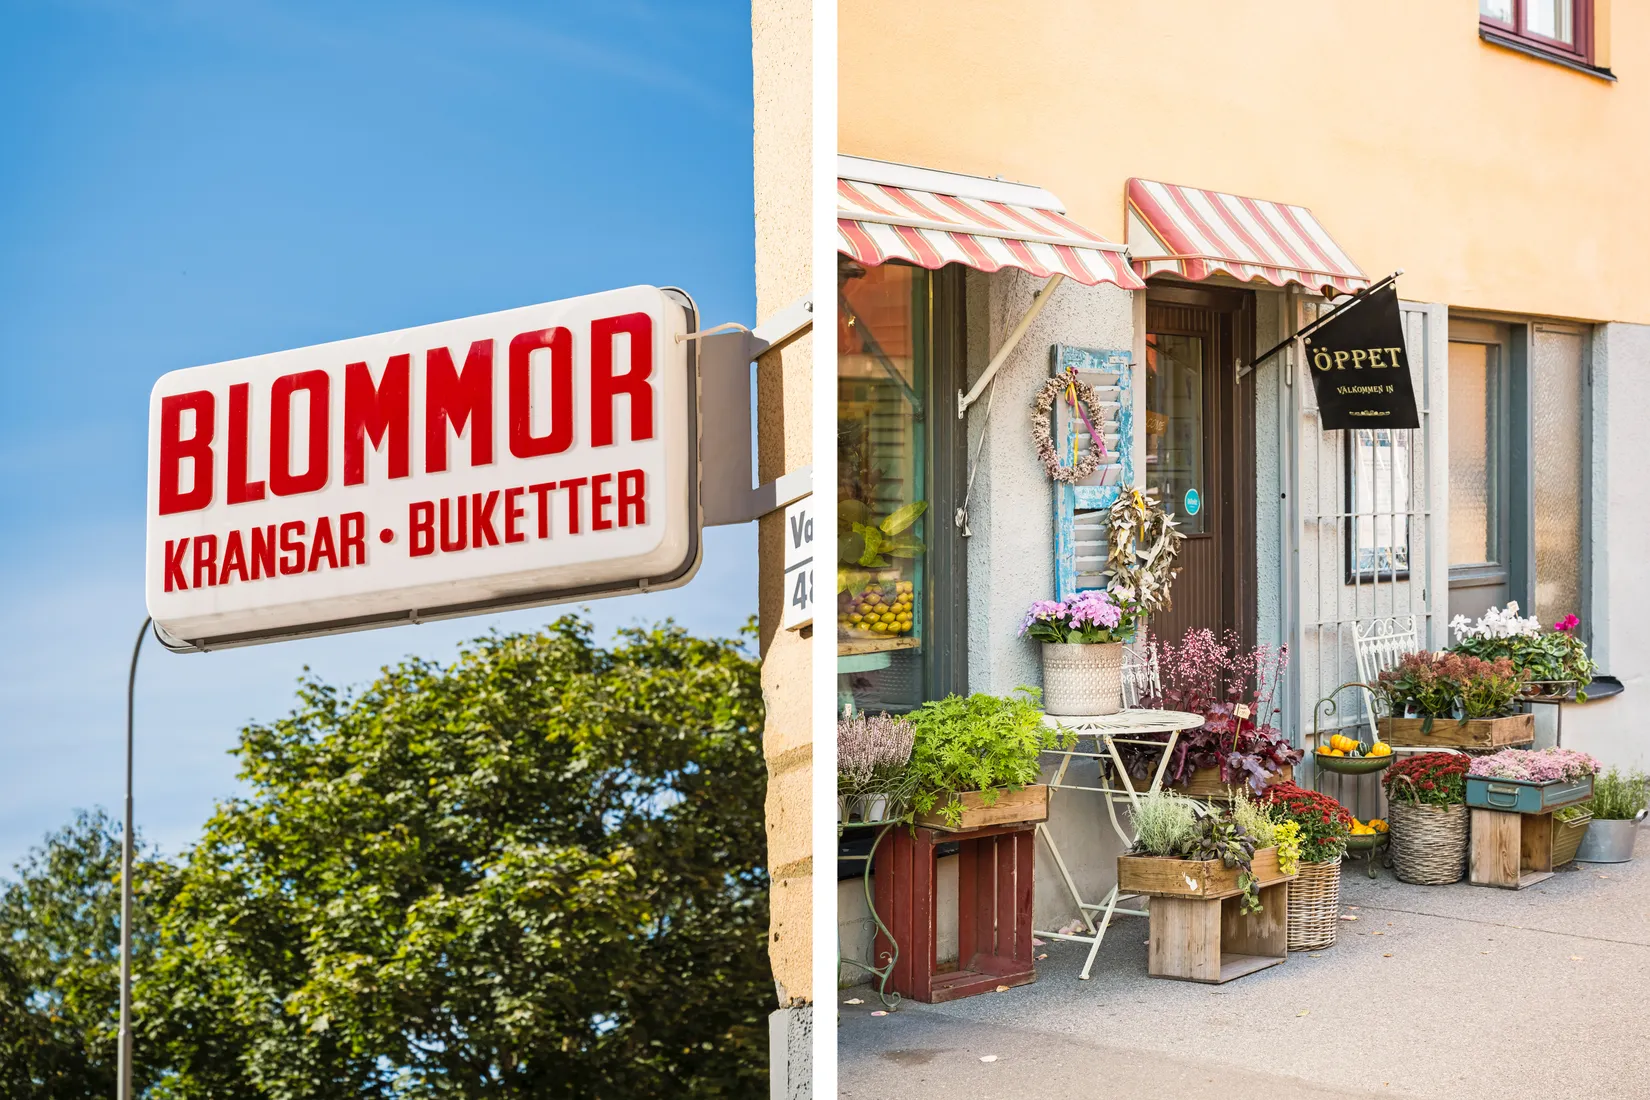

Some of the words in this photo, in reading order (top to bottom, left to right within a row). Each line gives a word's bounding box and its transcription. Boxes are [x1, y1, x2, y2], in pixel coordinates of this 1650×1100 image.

[1312, 346, 1402, 372] ÖPPET
[1385, 384, 1395, 394] IN
[158, 311, 654, 516] BLOMMOR
[164, 511, 366, 593] KRANSAR
[409, 468, 647, 558] BUKETTER
[792, 569, 814, 611] 4
